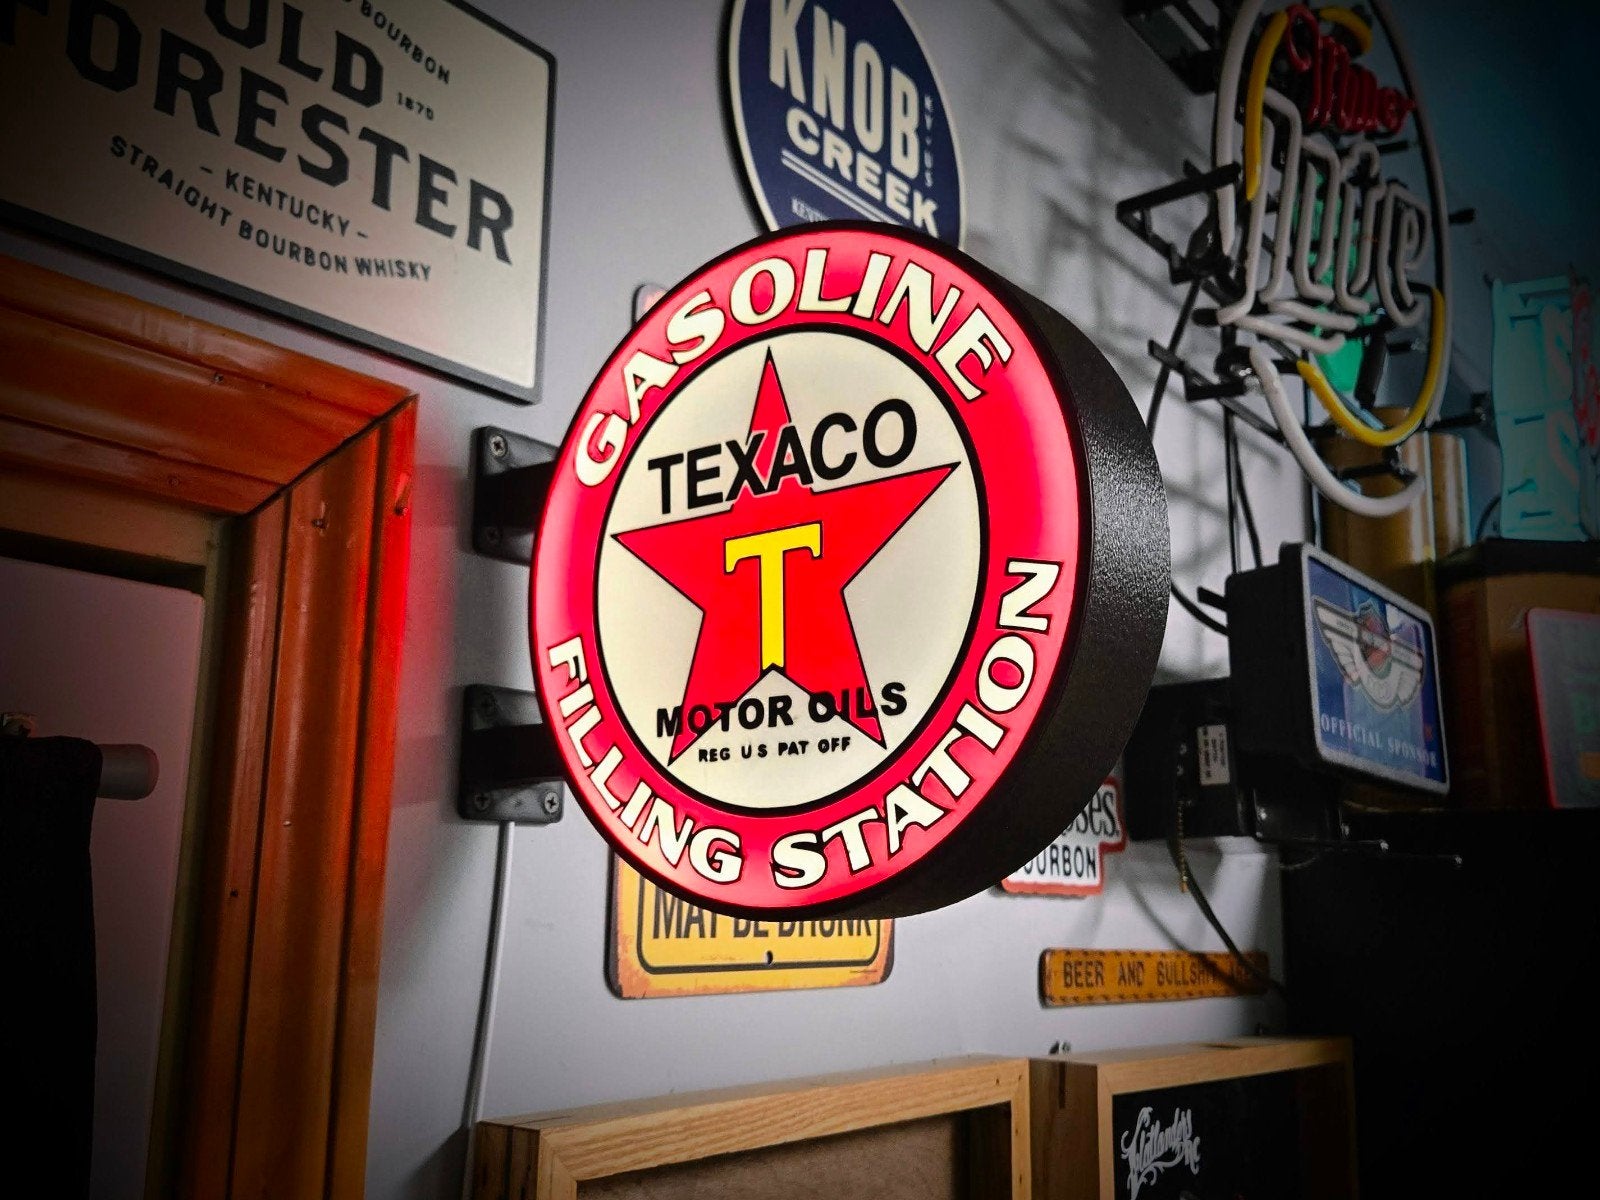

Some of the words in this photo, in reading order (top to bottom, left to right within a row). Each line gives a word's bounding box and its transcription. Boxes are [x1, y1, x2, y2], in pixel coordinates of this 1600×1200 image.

[205, 0, 384, 108] OLD
[361, 0, 450, 84] BOURBON
[769, 0, 920, 180] KNOB
[397, 91, 435, 121] 1870
[110, 136, 233, 227] STRAIGHT
[239, 220, 349, 275] BOURBON
[355, 256, 431, 282] WHISKY
[226, 169, 352, 238] KENTUCKY
[785, 106, 940, 239] CREEK
[573, 247, 1014, 488] GASOLINE
[647, 397, 919, 515] TEXACO
[723, 521, 823, 672] T
[547, 636, 743, 885] FILLING
[770, 559, 1065, 891] STATION
[655, 695, 794, 739] MOTOR
[807, 681, 908, 724] OILS
[698, 749, 731, 763] REG
[740, 747, 753, 760] U
[756, 746, 768, 759] S
[777, 741, 810, 757] PAT
[818, 736, 851, 754] OFF
[1319, 713, 1382, 750] OFFICIAL
[1063, 960, 1104, 988] BEER
[1117, 961, 1144, 987] AND
